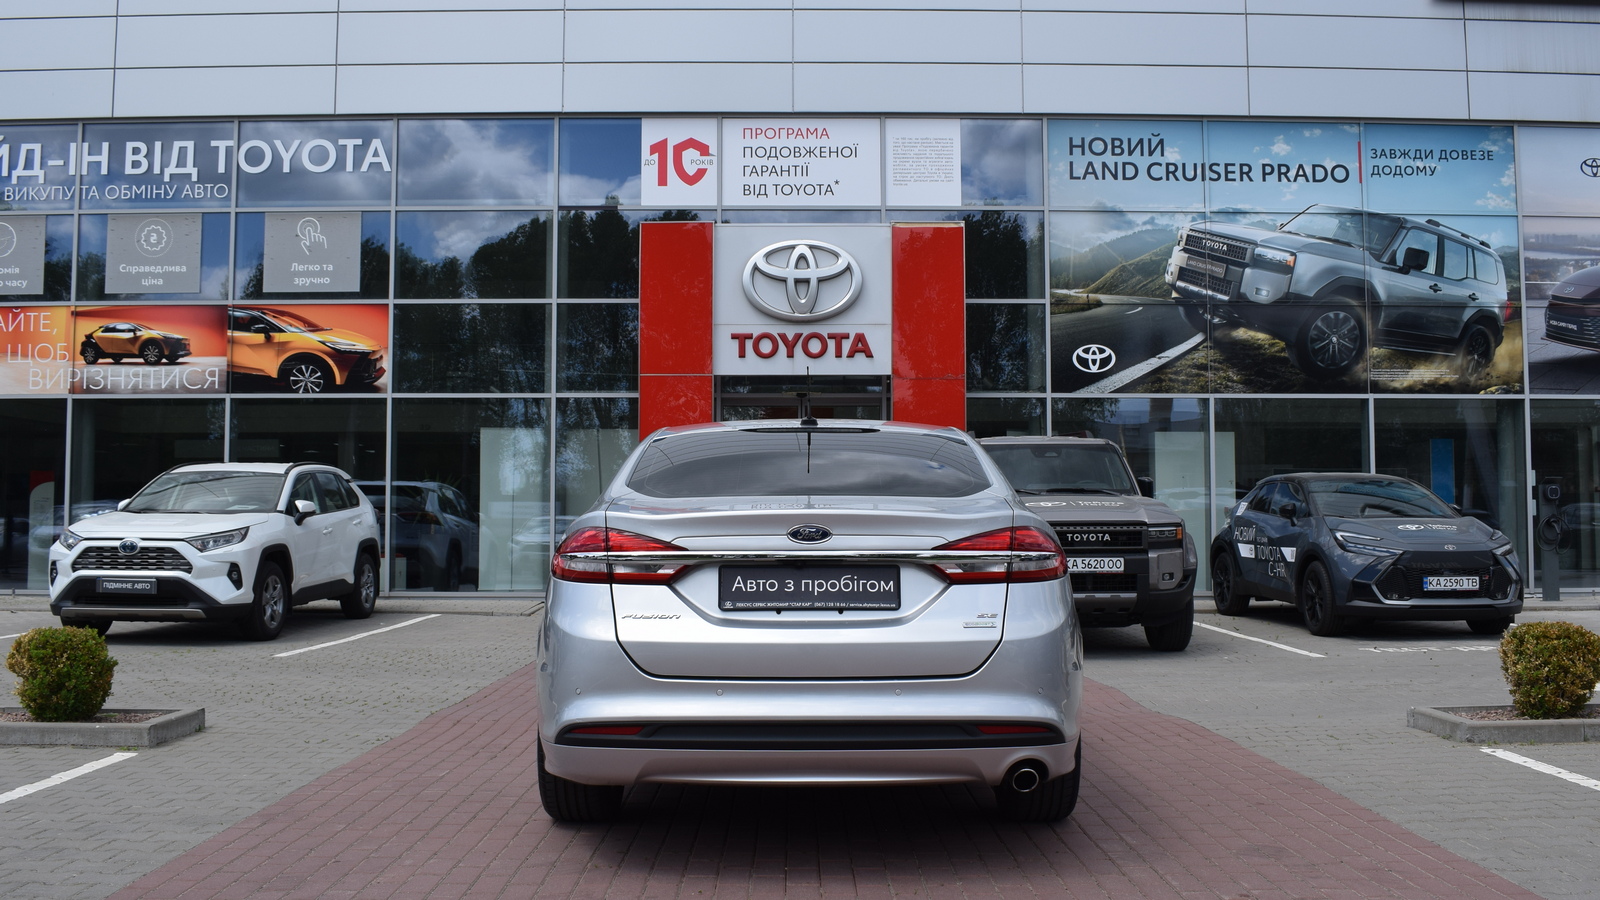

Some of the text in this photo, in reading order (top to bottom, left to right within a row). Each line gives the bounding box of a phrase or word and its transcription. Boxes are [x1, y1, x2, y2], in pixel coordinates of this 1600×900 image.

[743, 127, 830, 140] ПРОГРАМА
[743, 143, 859, 160] ПОДОВЖЕНОЇ
[1068, 133, 1165, 157] НОВИЙ
[124, 141, 198, 182] ВІД
[210, 138, 392, 174] TOYOTA
[649, 137, 710, 187] 10
[1370, 148, 1494, 162] ЗАВЖДИ ДОВЕЗЕ
[644, 159, 656, 167] ДО
[743, 162, 810, 177] ГАРАНТІЇ
[1068, 161, 1350, 183] LAND CRUISER PRADO
[1370, 165, 1437, 178] ДОДОМУ
[4, 183, 229, 201] ВИКУПУ ТА ОБМІНУ АВТО
[743, 184, 768, 198] ВІД
[1202, 240, 1228, 251] TOYOTA
[119, 263, 187, 274] Справедлива
[290, 263, 320, 272] Легко
[5, 280, 28, 289] часу
[141, 277, 163, 286] ціна
[293, 277, 331, 286] зручно
[731, 332, 874, 359] TOYOTA
[7, 343, 69, 366] ЩОБ
[29, 367, 219, 390] ВИРІЗНЯТИСЯ
[797, 527, 823, 540] Ford
[1066, 533, 1111, 541] TOYOTA
[1233, 525, 1256, 541] НОВИЙ
[1256, 545, 1282, 561] TOYOTA
[1081, 559, 1105, 569] 5620
[1268, 561, 1287, 578] C-HR
[731, 574, 894, 595] Авто з пробігом
[1428, 578, 1478, 588] KA 2590 TB
